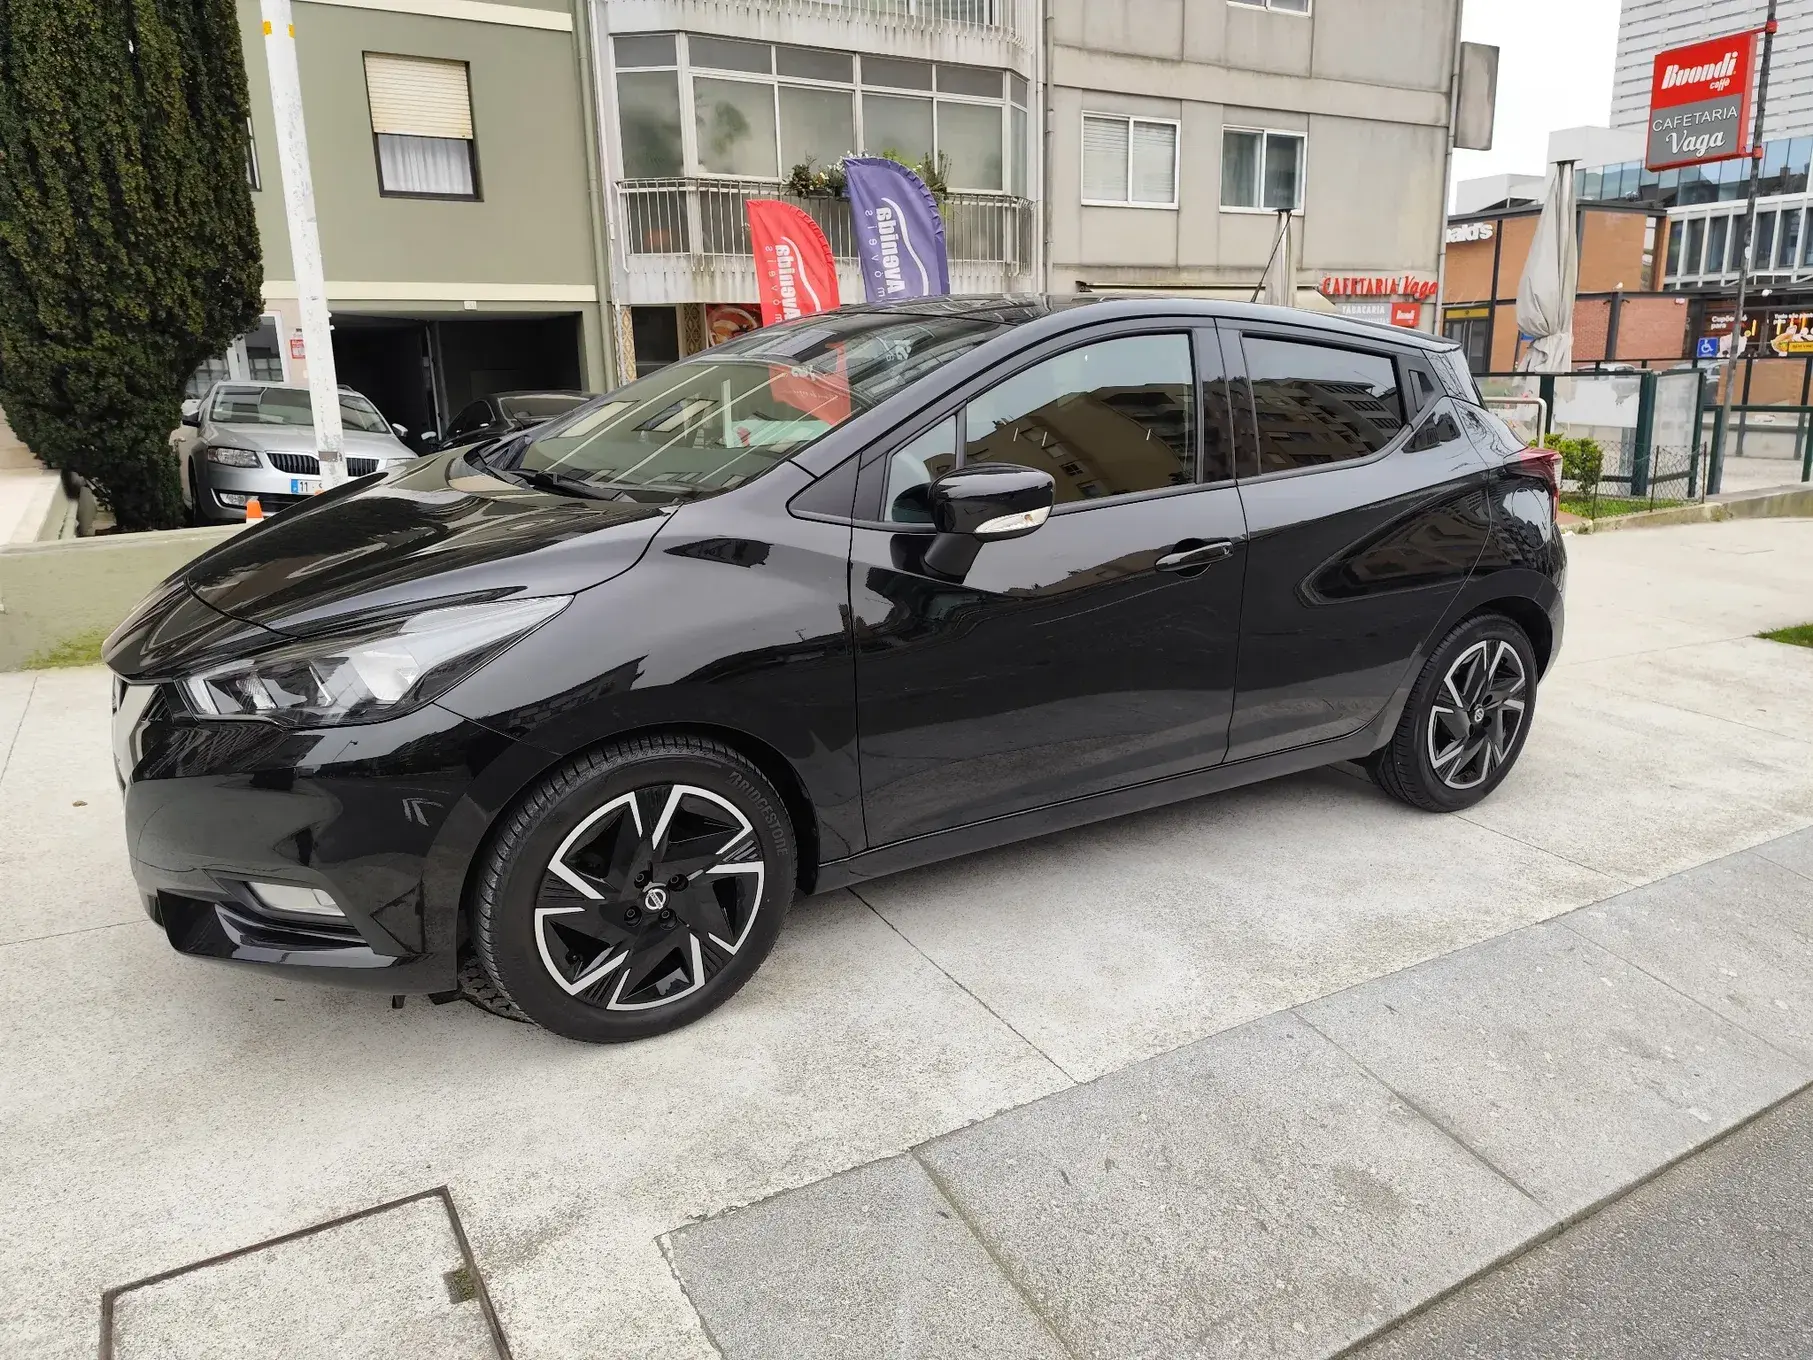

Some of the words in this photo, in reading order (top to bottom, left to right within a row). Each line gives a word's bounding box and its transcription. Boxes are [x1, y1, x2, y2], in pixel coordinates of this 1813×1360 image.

[1661, 51, 1739, 90] Buondi
[1652, 106, 1738, 132] CAFETARIA
[1665, 130, 1726, 157] Vaga
[1322, 276, 1398, 295] CAFETARIA
[1403, 275, 1438, 301] Vaga
[724, 771, 789, 857] BRIDGESTONE
